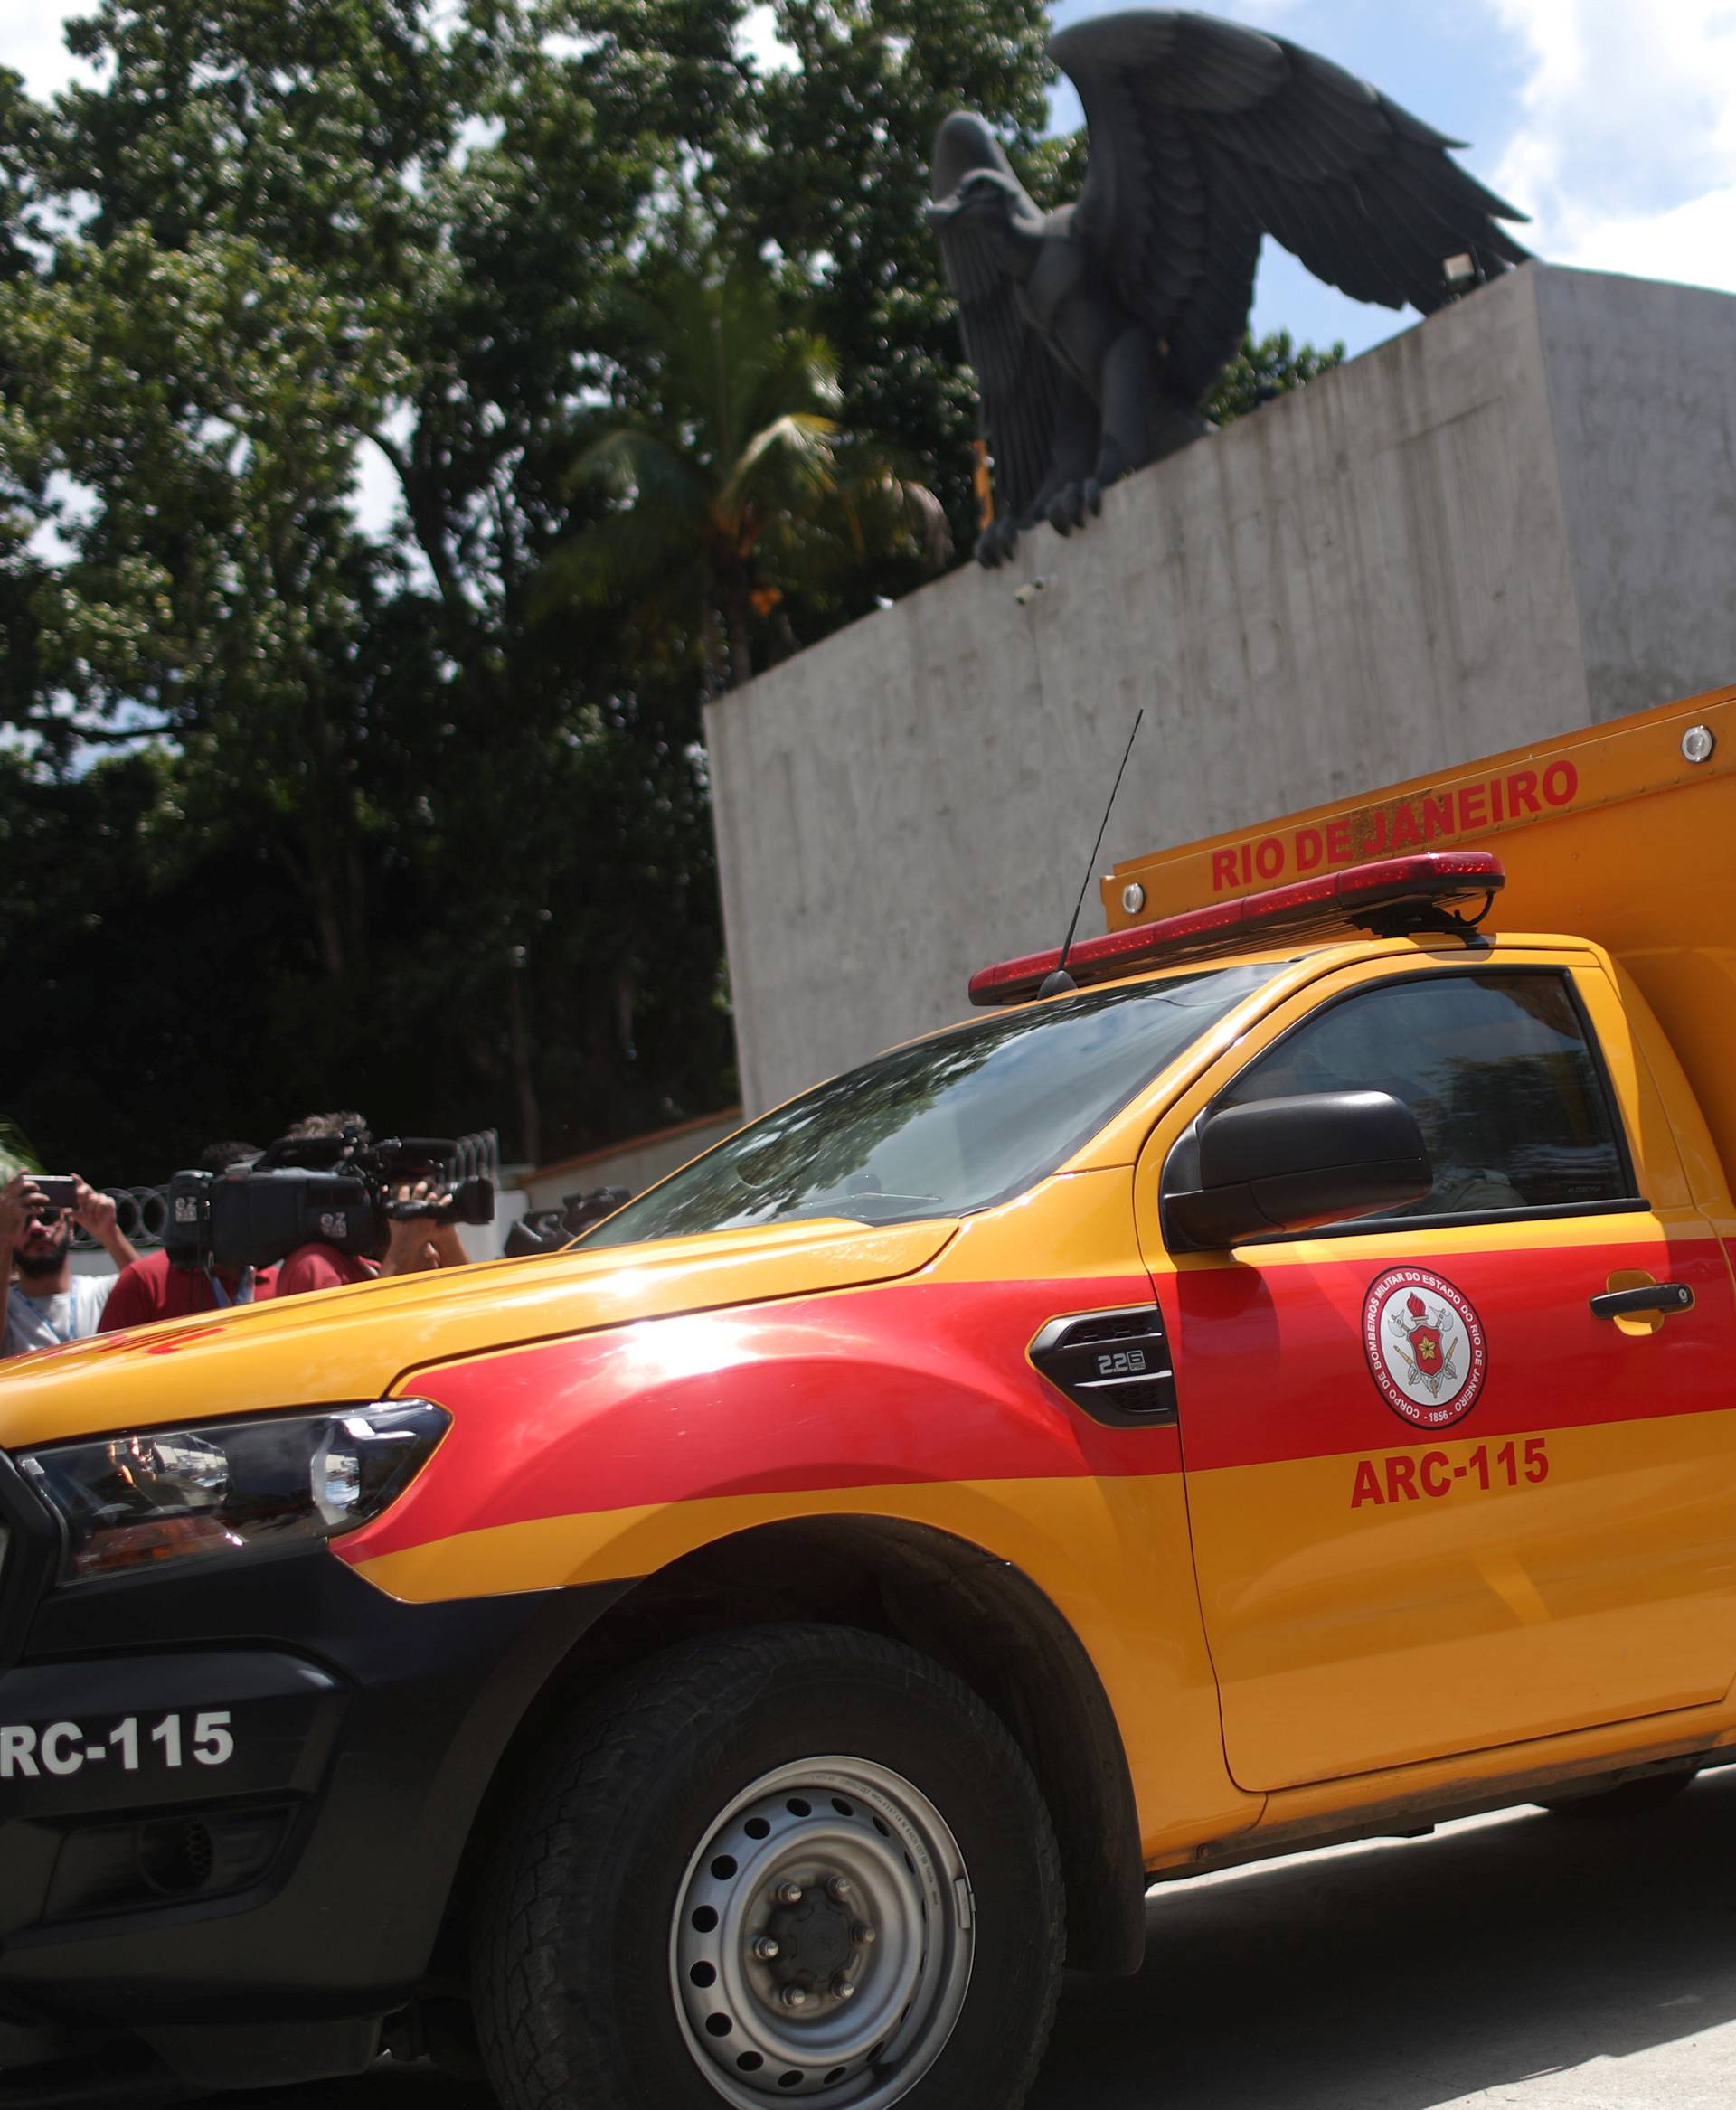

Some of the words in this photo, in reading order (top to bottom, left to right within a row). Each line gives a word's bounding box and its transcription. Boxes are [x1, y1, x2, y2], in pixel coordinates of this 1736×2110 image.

[1212, 839, 1285, 891] RIO
[1296, 820, 1354, 873] DE
[1363, 760, 1578, 854] JANEIRO
[1375, 1273, 1405, 1301] MILITAR
[1405, 1272, 1420, 1282] DO
[1422, 1275, 1461, 1305] ESTADO
[1460, 1305, 1473, 1322] DO
[1367, 1296, 1382, 1370] BOMBEIROS
[1470, 1324, 1482, 1346] RIO
[1475, 1349, 1483, 1366] DE
[1378, 1371, 1391, 1389] DE
[1455, 1365, 1483, 1412] JANEIRO
[1389, 1390, 1420, 1418] CORPO
[1351, 1437, 1550, 1509] ARC-115
